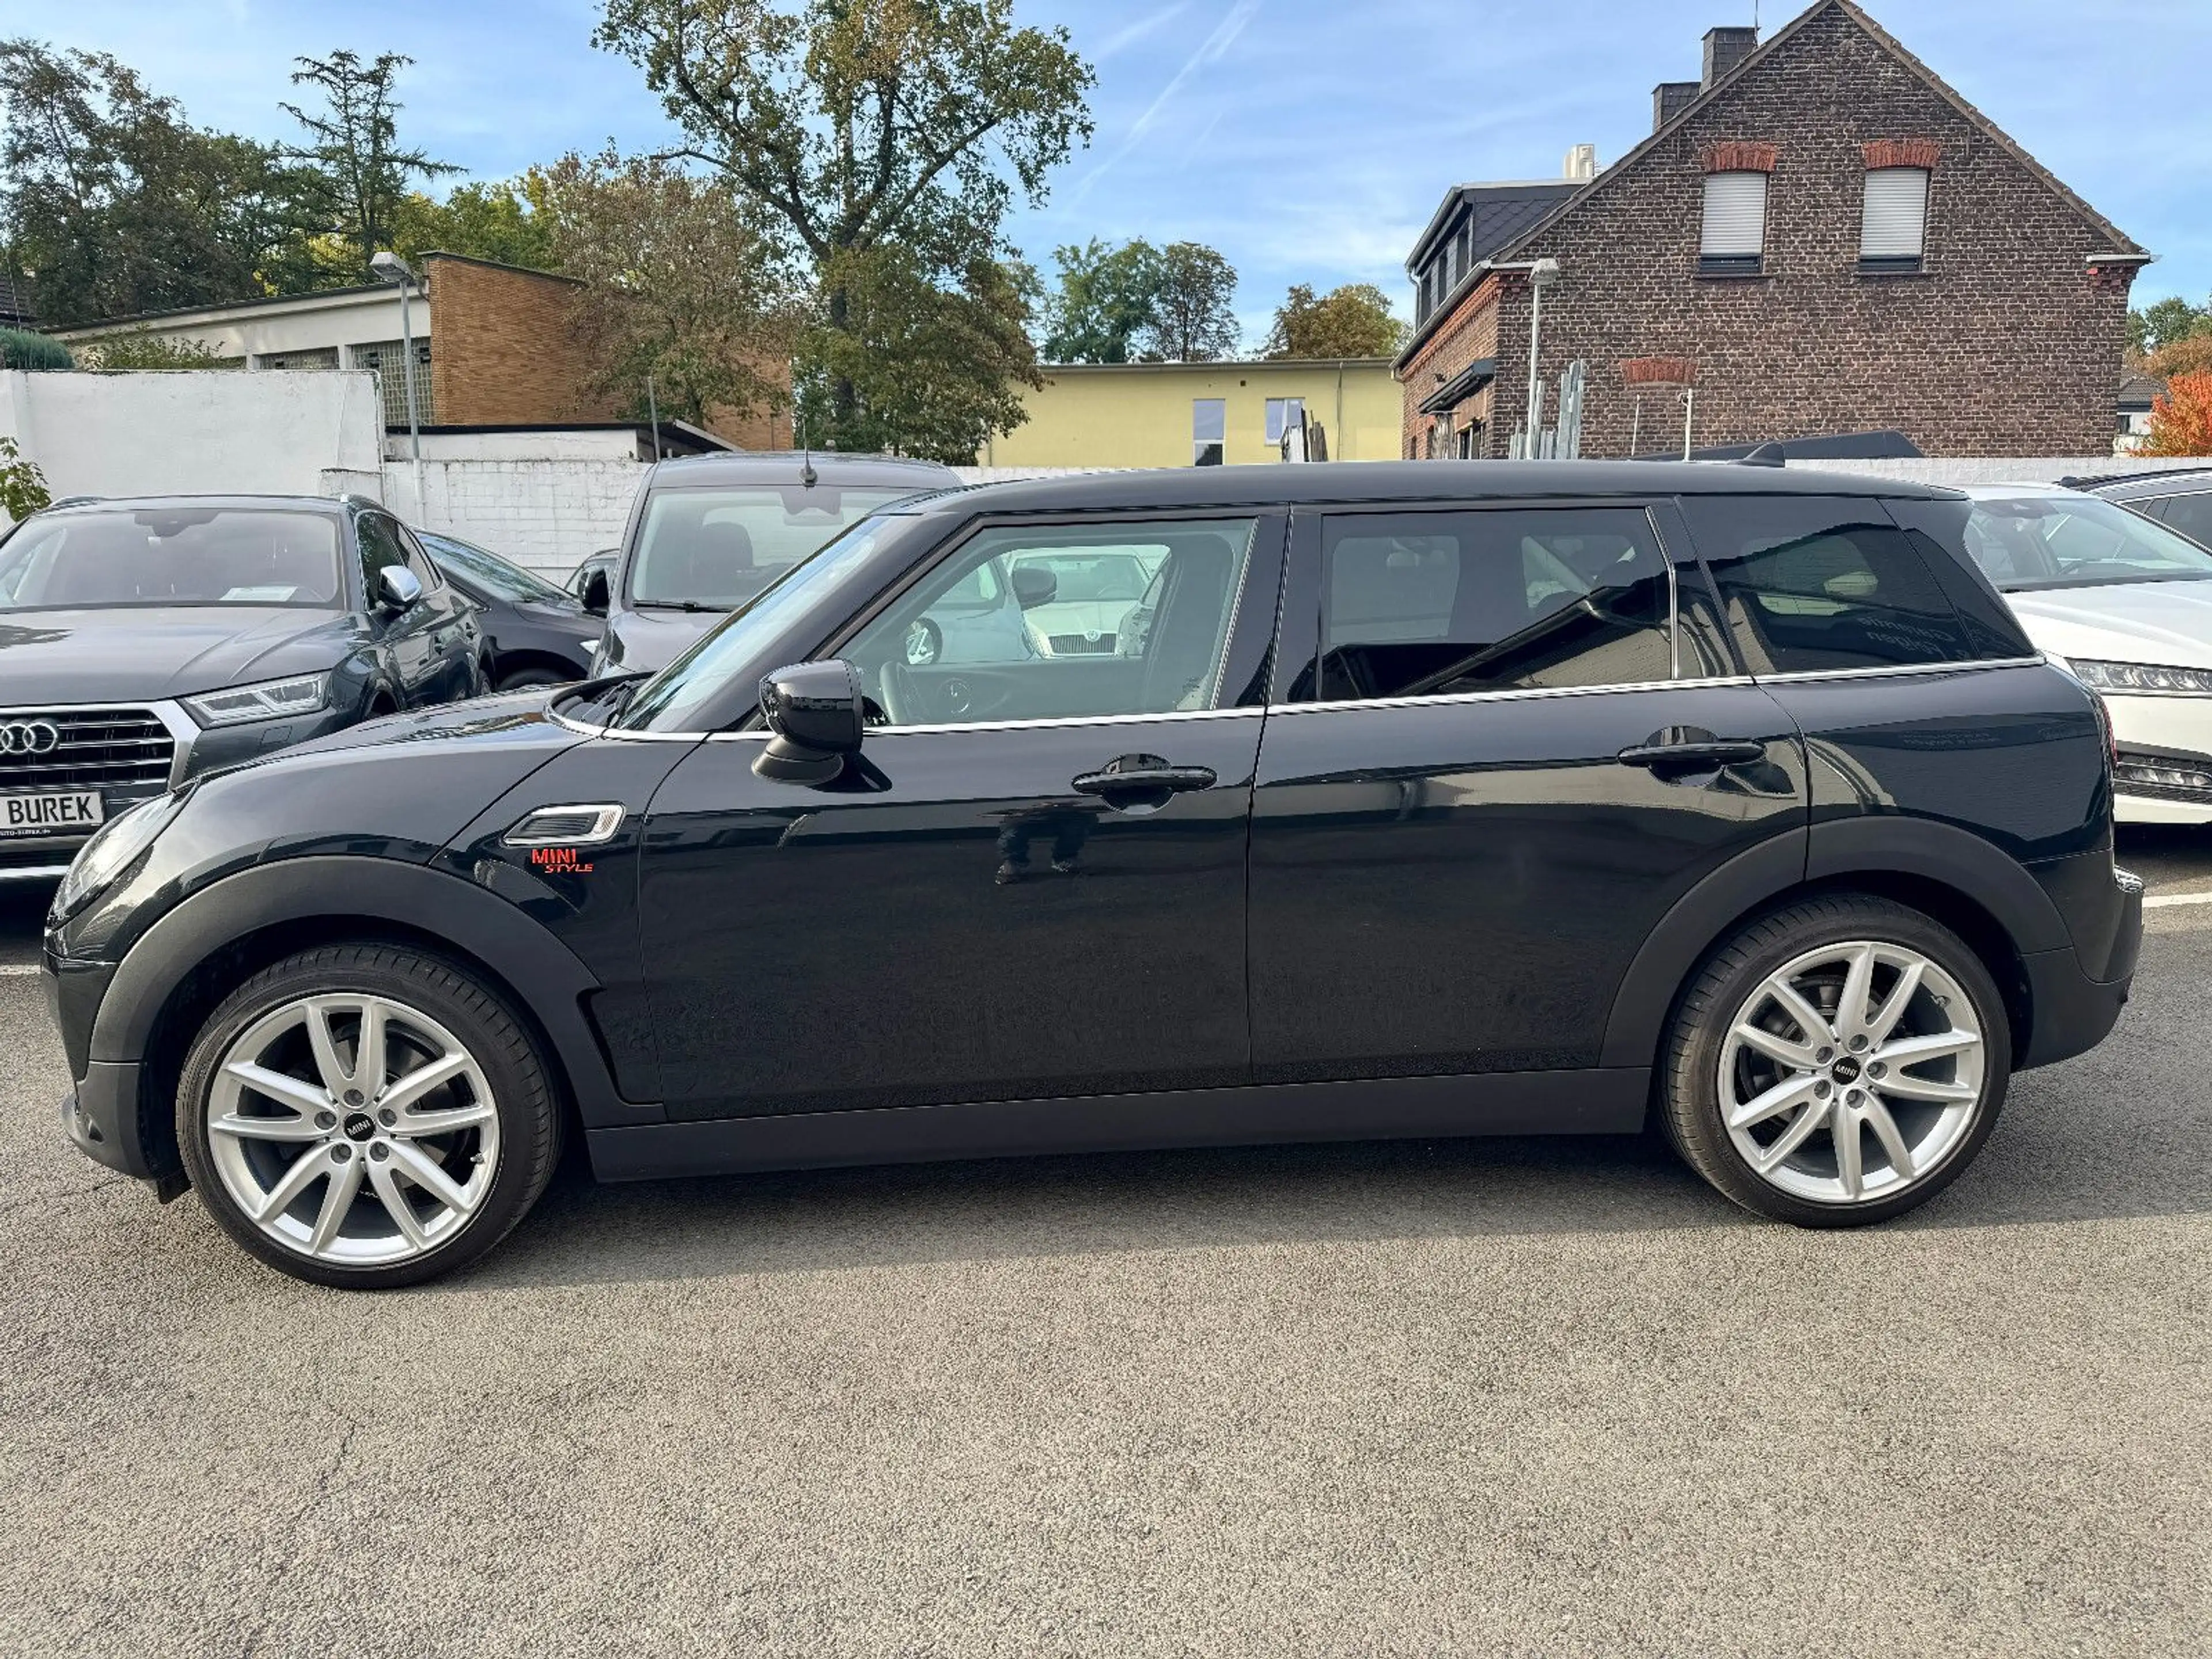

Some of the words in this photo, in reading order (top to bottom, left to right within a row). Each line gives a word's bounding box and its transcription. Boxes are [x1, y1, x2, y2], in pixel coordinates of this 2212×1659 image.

[7, 796, 94, 824] BUREK
[532, 848, 576, 863] MINI
[544, 863, 593, 873] STYLE
[1835, 1064, 1858, 1077] MINI
[347, 1119, 371, 1136] MINI
